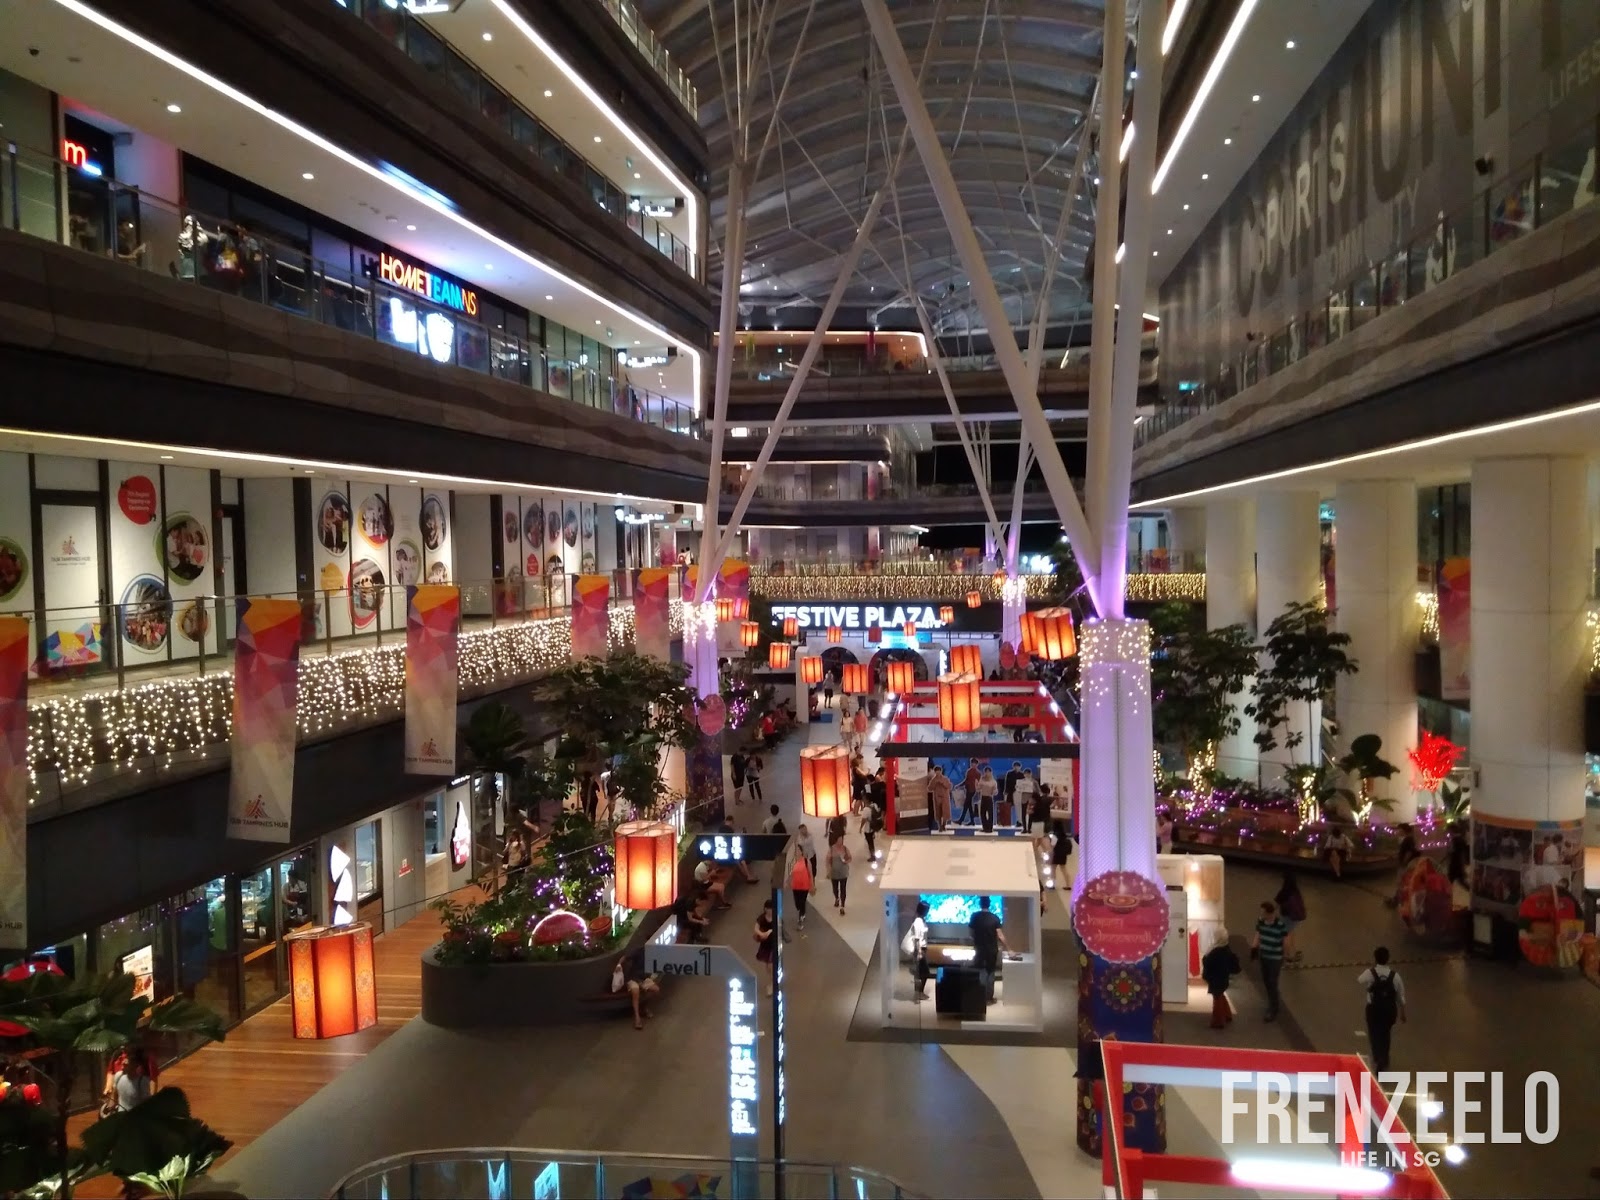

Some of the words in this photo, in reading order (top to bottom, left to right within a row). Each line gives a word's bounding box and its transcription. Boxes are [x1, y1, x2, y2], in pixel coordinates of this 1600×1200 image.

[380, 252, 478, 316] HOMETEAMNS
[865, 606, 937, 628] PLAZA
[243, 818, 273, 828] TAMPINES
[273, 820, 289, 829] HUB
[653, 959, 698, 976] Level
[699, 947, 711, 976] 1
